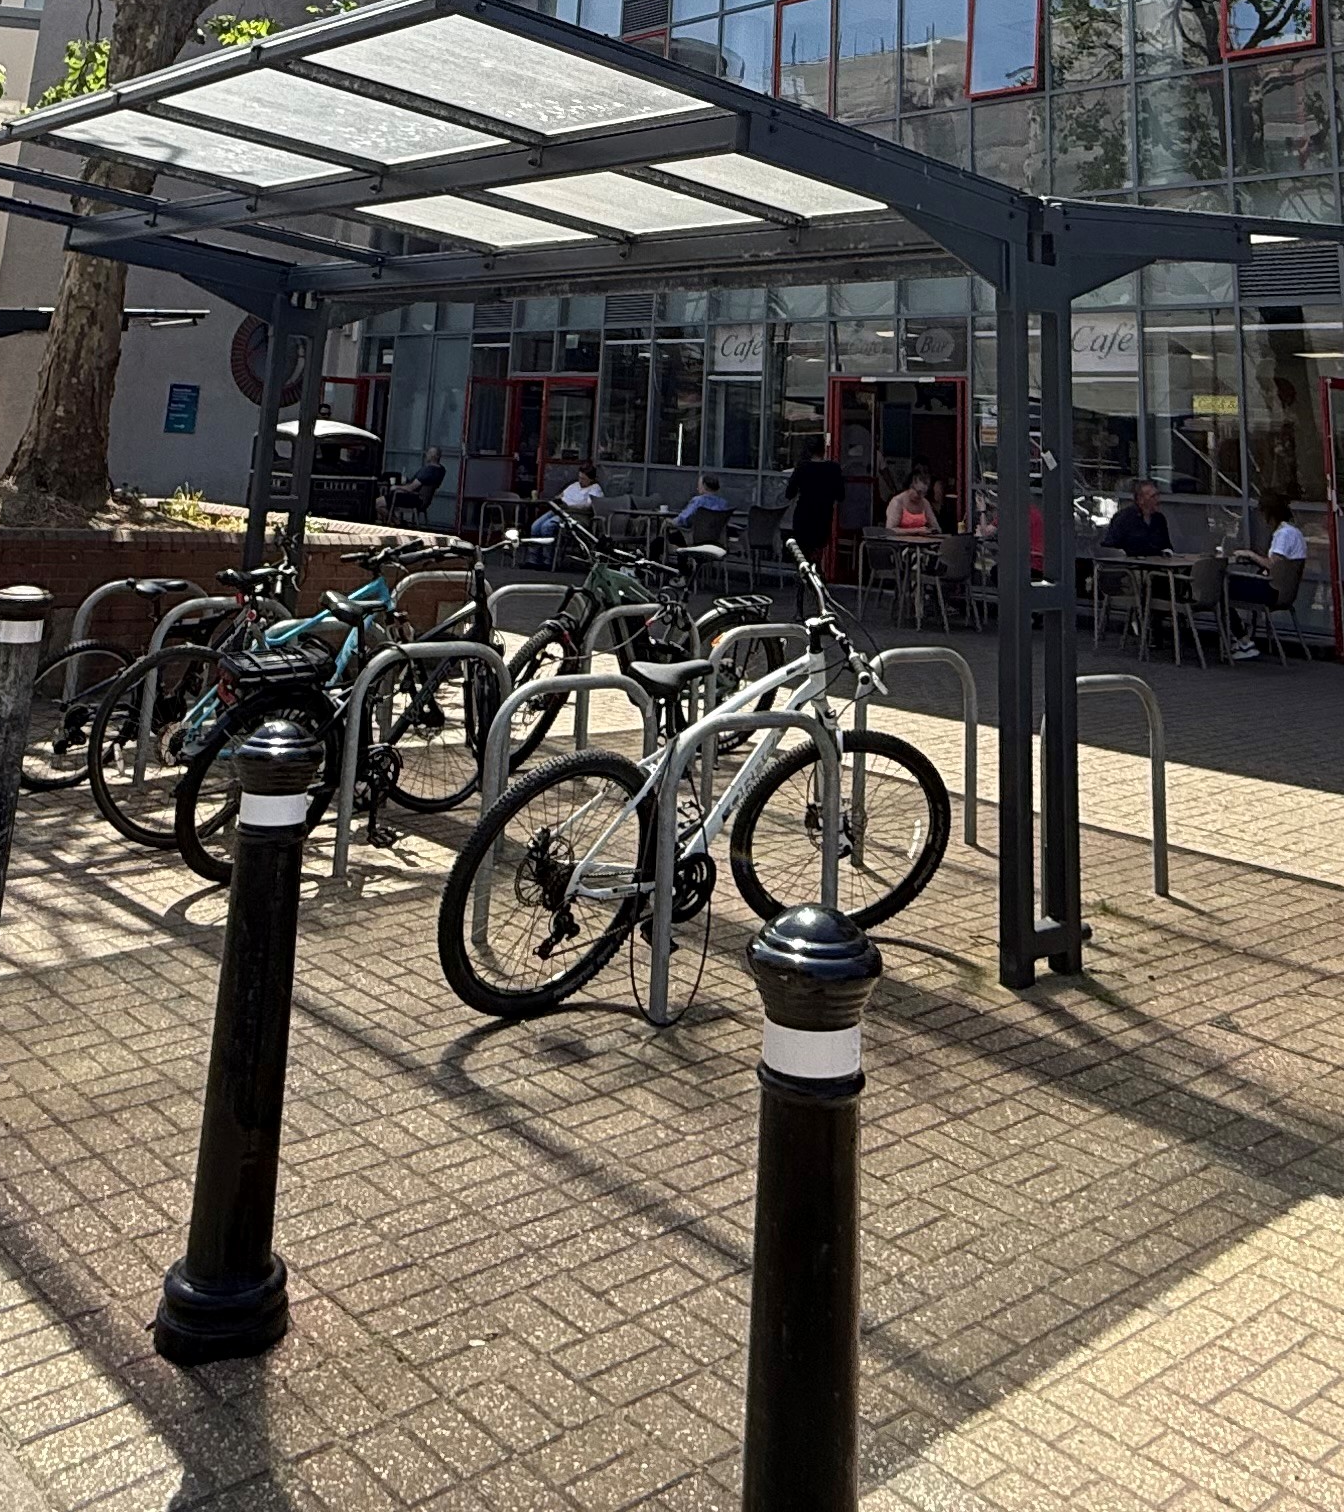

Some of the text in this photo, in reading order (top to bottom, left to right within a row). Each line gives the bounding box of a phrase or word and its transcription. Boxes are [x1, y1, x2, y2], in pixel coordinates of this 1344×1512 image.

[721, 334, 763, 362] Café
[920, 337, 946, 354] Bar
[1071, 321, 1135, 359] Café
[323, 480, 358, 491] LITTER
